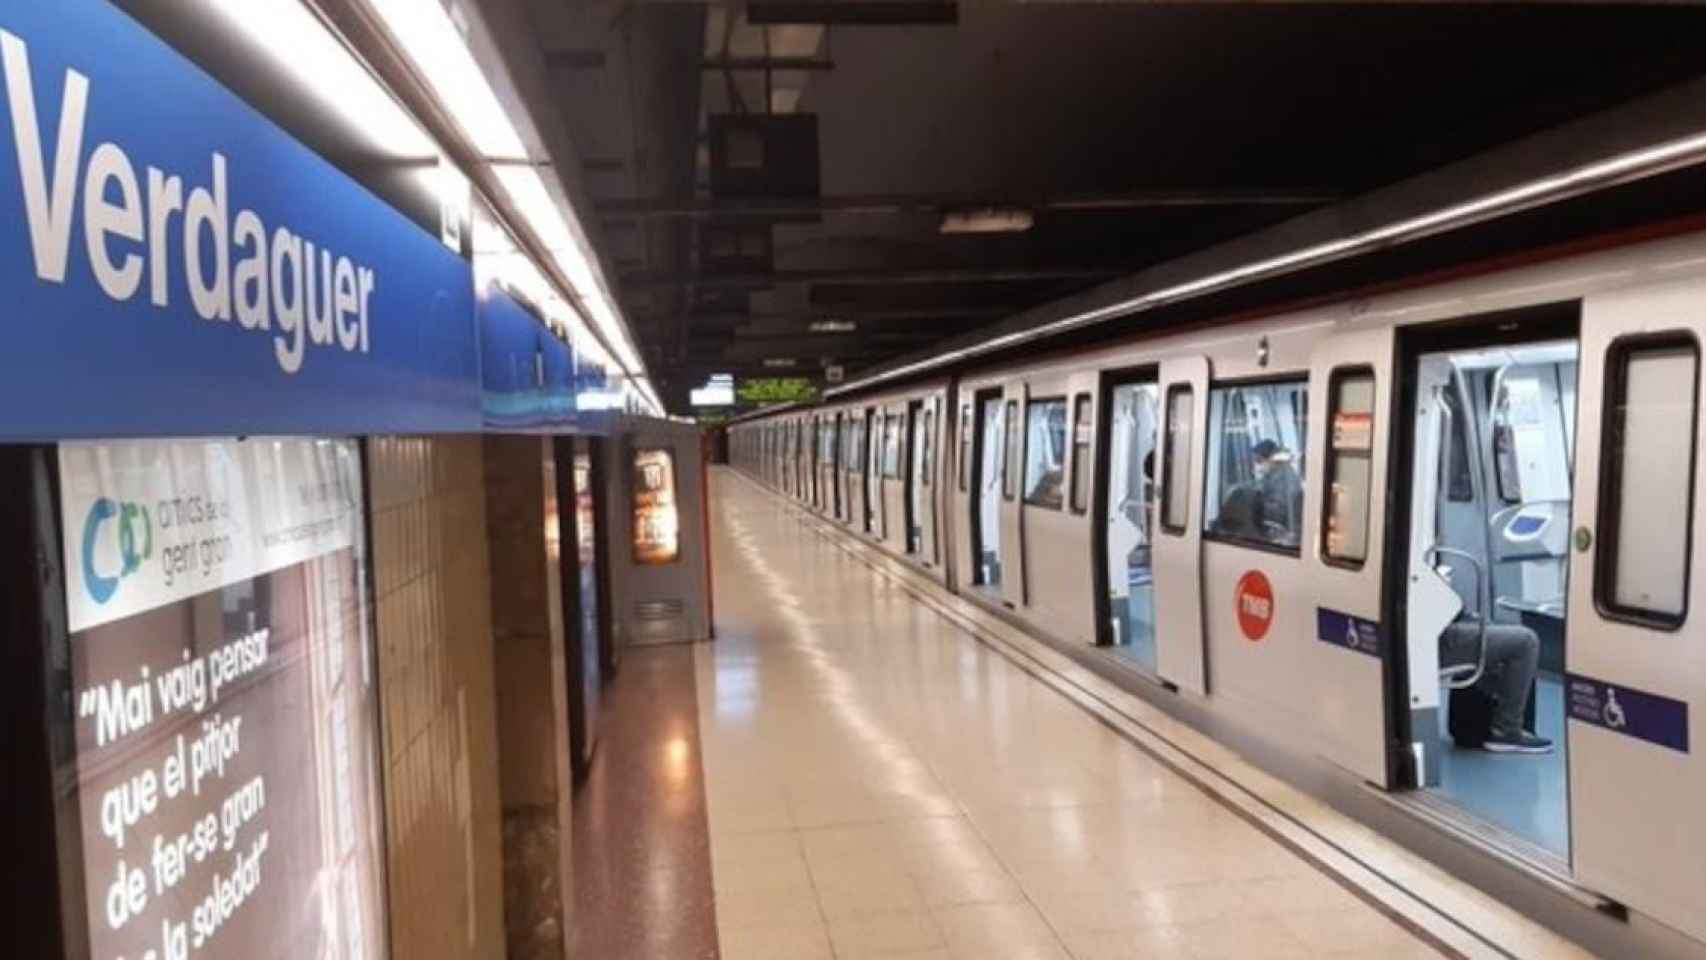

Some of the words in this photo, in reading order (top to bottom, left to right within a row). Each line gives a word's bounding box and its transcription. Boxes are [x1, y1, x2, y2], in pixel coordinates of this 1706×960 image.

[0, 28, 374, 374] Verdaguer
[157, 648, 207, 713] vaig
[209, 628, 270, 703] pensar
[102, 769, 158, 849] que
[163, 734, 186, 798] el
[192, 713, 242, 795] pitjor
[106, 858, 148, 930] de
[152, 813, 218, 895] fer-se
[221, 775, 267, 850] gran
